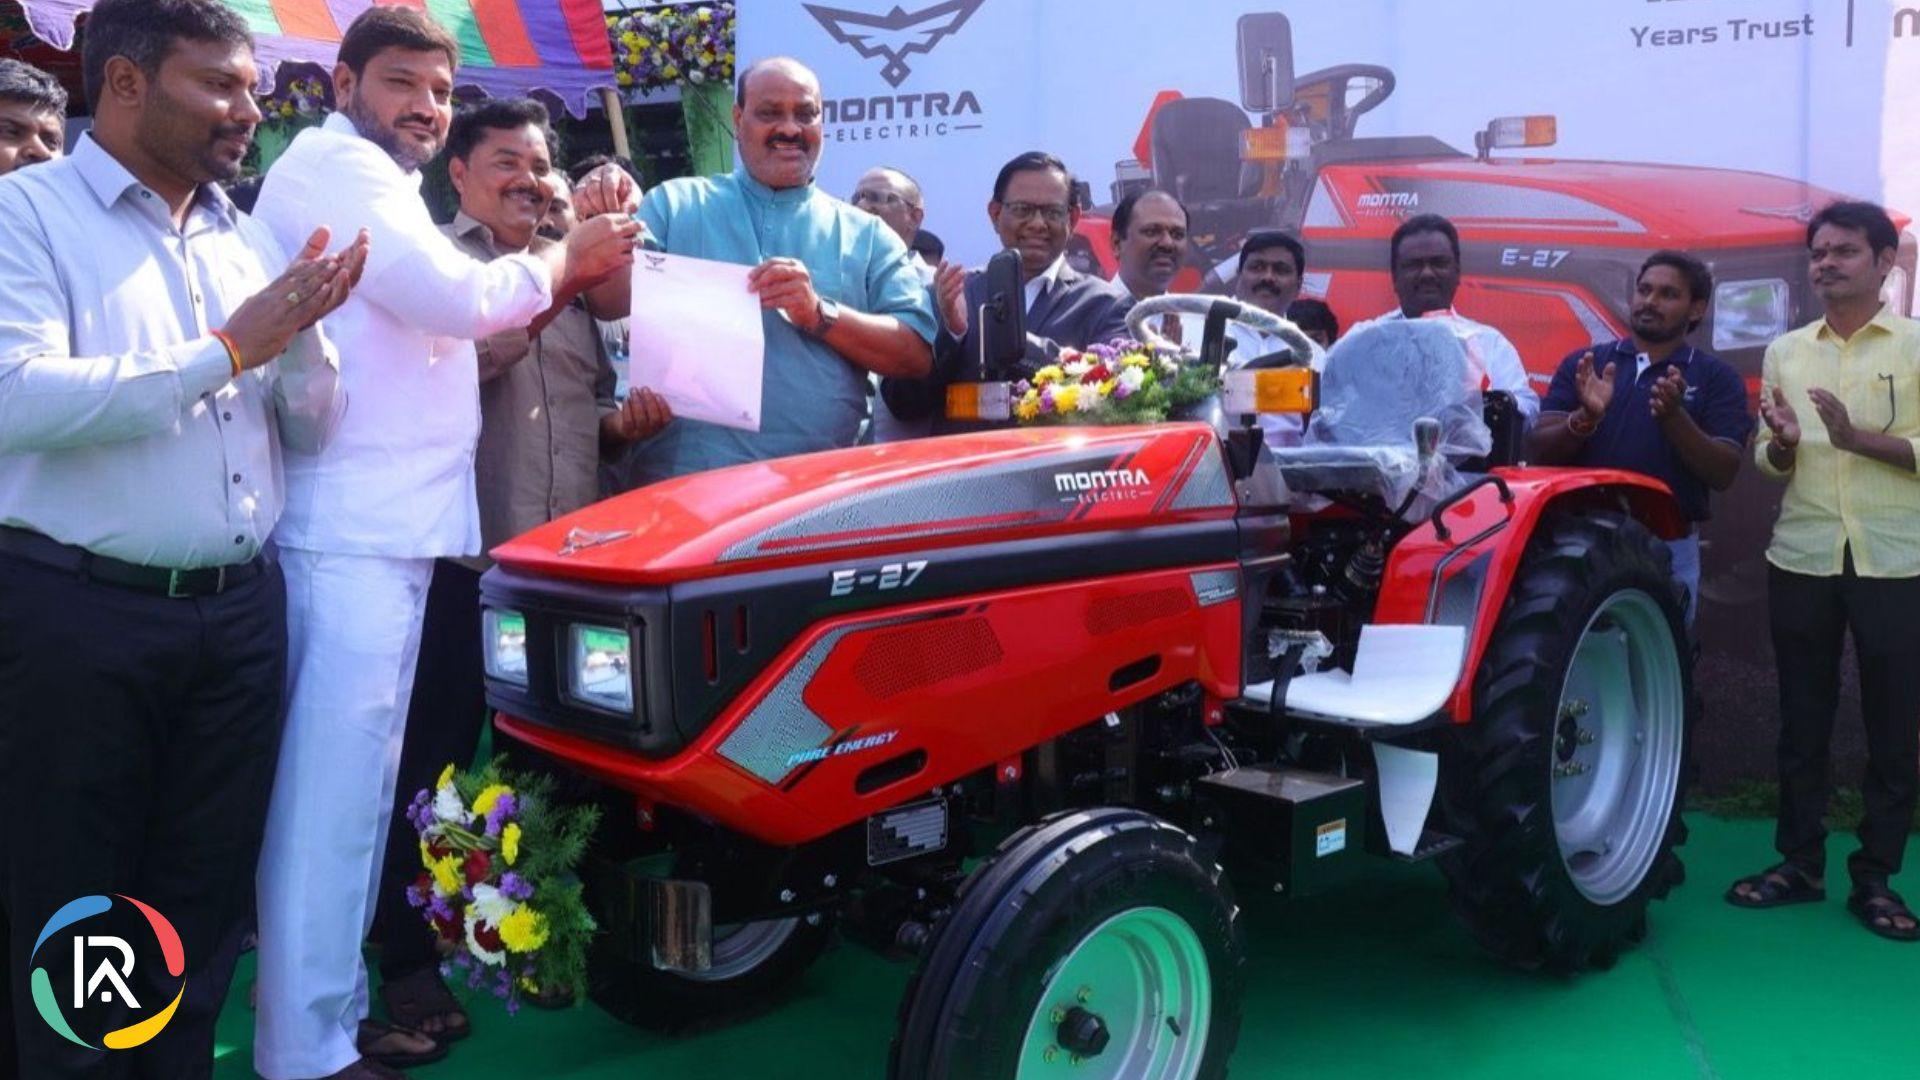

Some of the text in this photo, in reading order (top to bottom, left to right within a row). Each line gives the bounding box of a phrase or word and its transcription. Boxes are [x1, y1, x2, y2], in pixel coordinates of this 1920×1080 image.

[1630, 14, 1814, 47] Years Trust
[836, 123, 948, 142] ELECTRIC
[1358, 192, 1418, 207] MONTRA
[1501, 248, 1570, 268] E-27
[1054, 468, 1150, 492] MONTRA
[830, 560, 928, 597] E-27
[786, 730, 899, 768] PURE ENERGY
